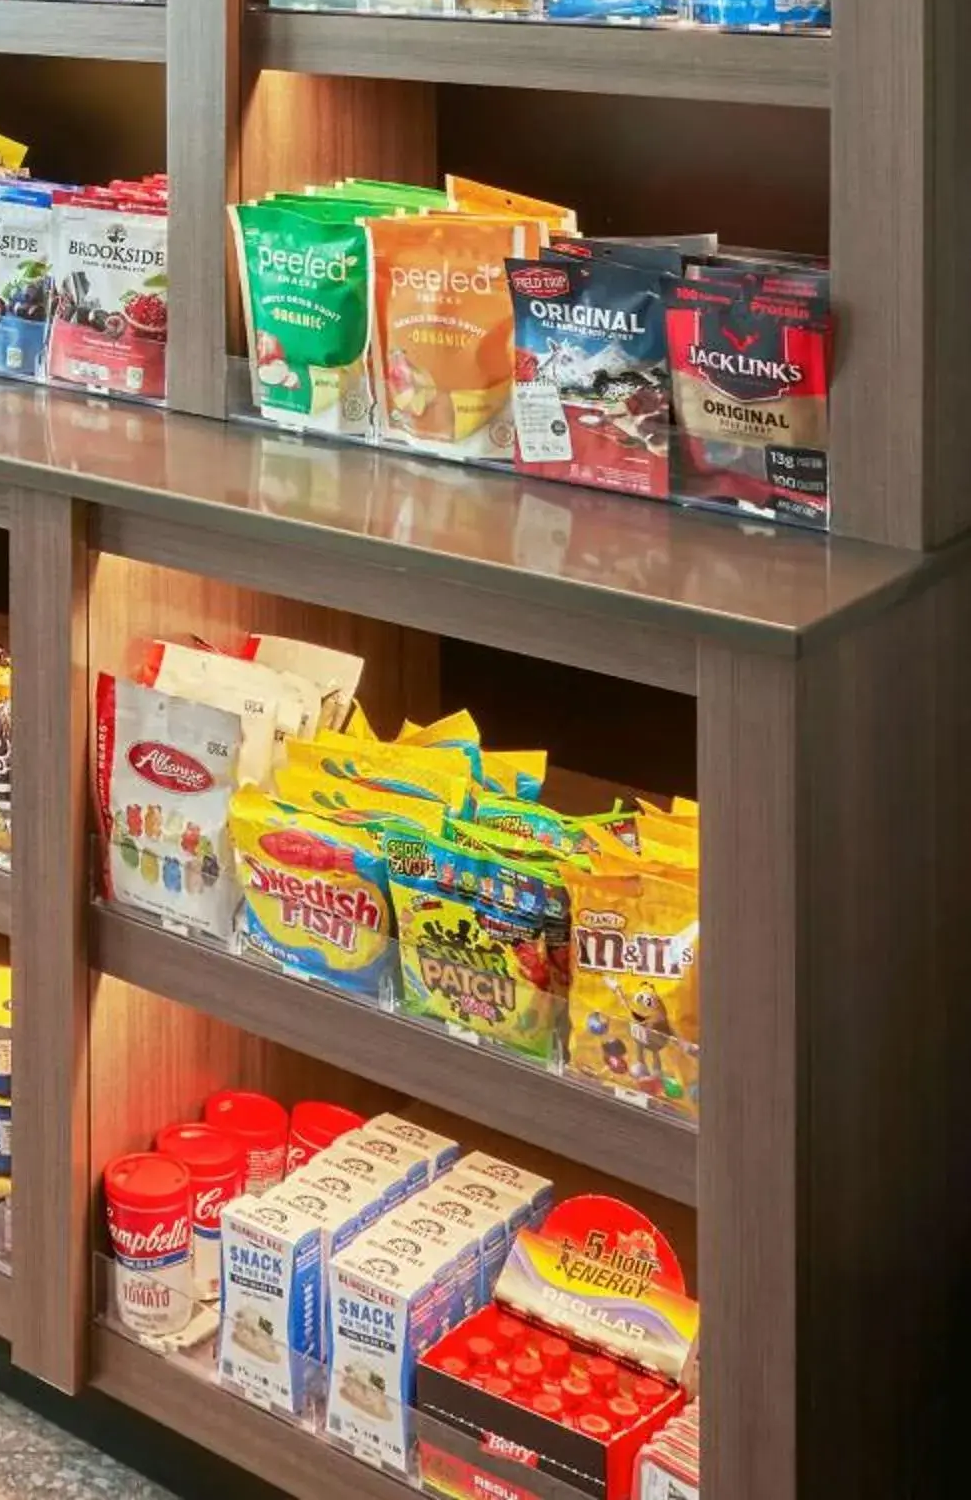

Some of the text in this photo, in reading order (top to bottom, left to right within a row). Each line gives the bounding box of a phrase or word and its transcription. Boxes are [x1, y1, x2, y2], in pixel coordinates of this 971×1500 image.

[68, 240, 165, 267] BROOKSIDE
[257, 244, 347, 282] peeled
[390, 260, 492, 296] peeled
[530, 300, 646, 333] ORIGINAL
[750, 302, 810, 319] Protein
[689, 344, 803, 382] JACK LINK'S
[703, 399, 790, 429] ORIGINAL
[770, 451, 795, 469] 13g
[245, 856, 379, 932] Swedish
[280, 895, 357, 950] Fish
[420, 957, 517, 1012] PATCH
[230, 1246, 283, 1276] SNACK
[585, 1230, 655, 1277] 5-hour
[122, 1283, 170, 1308] TOMATO
[570, 1260, 651, 1298] ENERGY
[338, 1297, 396, 1330] SNACK
[542, 1286, 646, 1341] REGULAR
[489, 1433, 532, 1463] Berry
